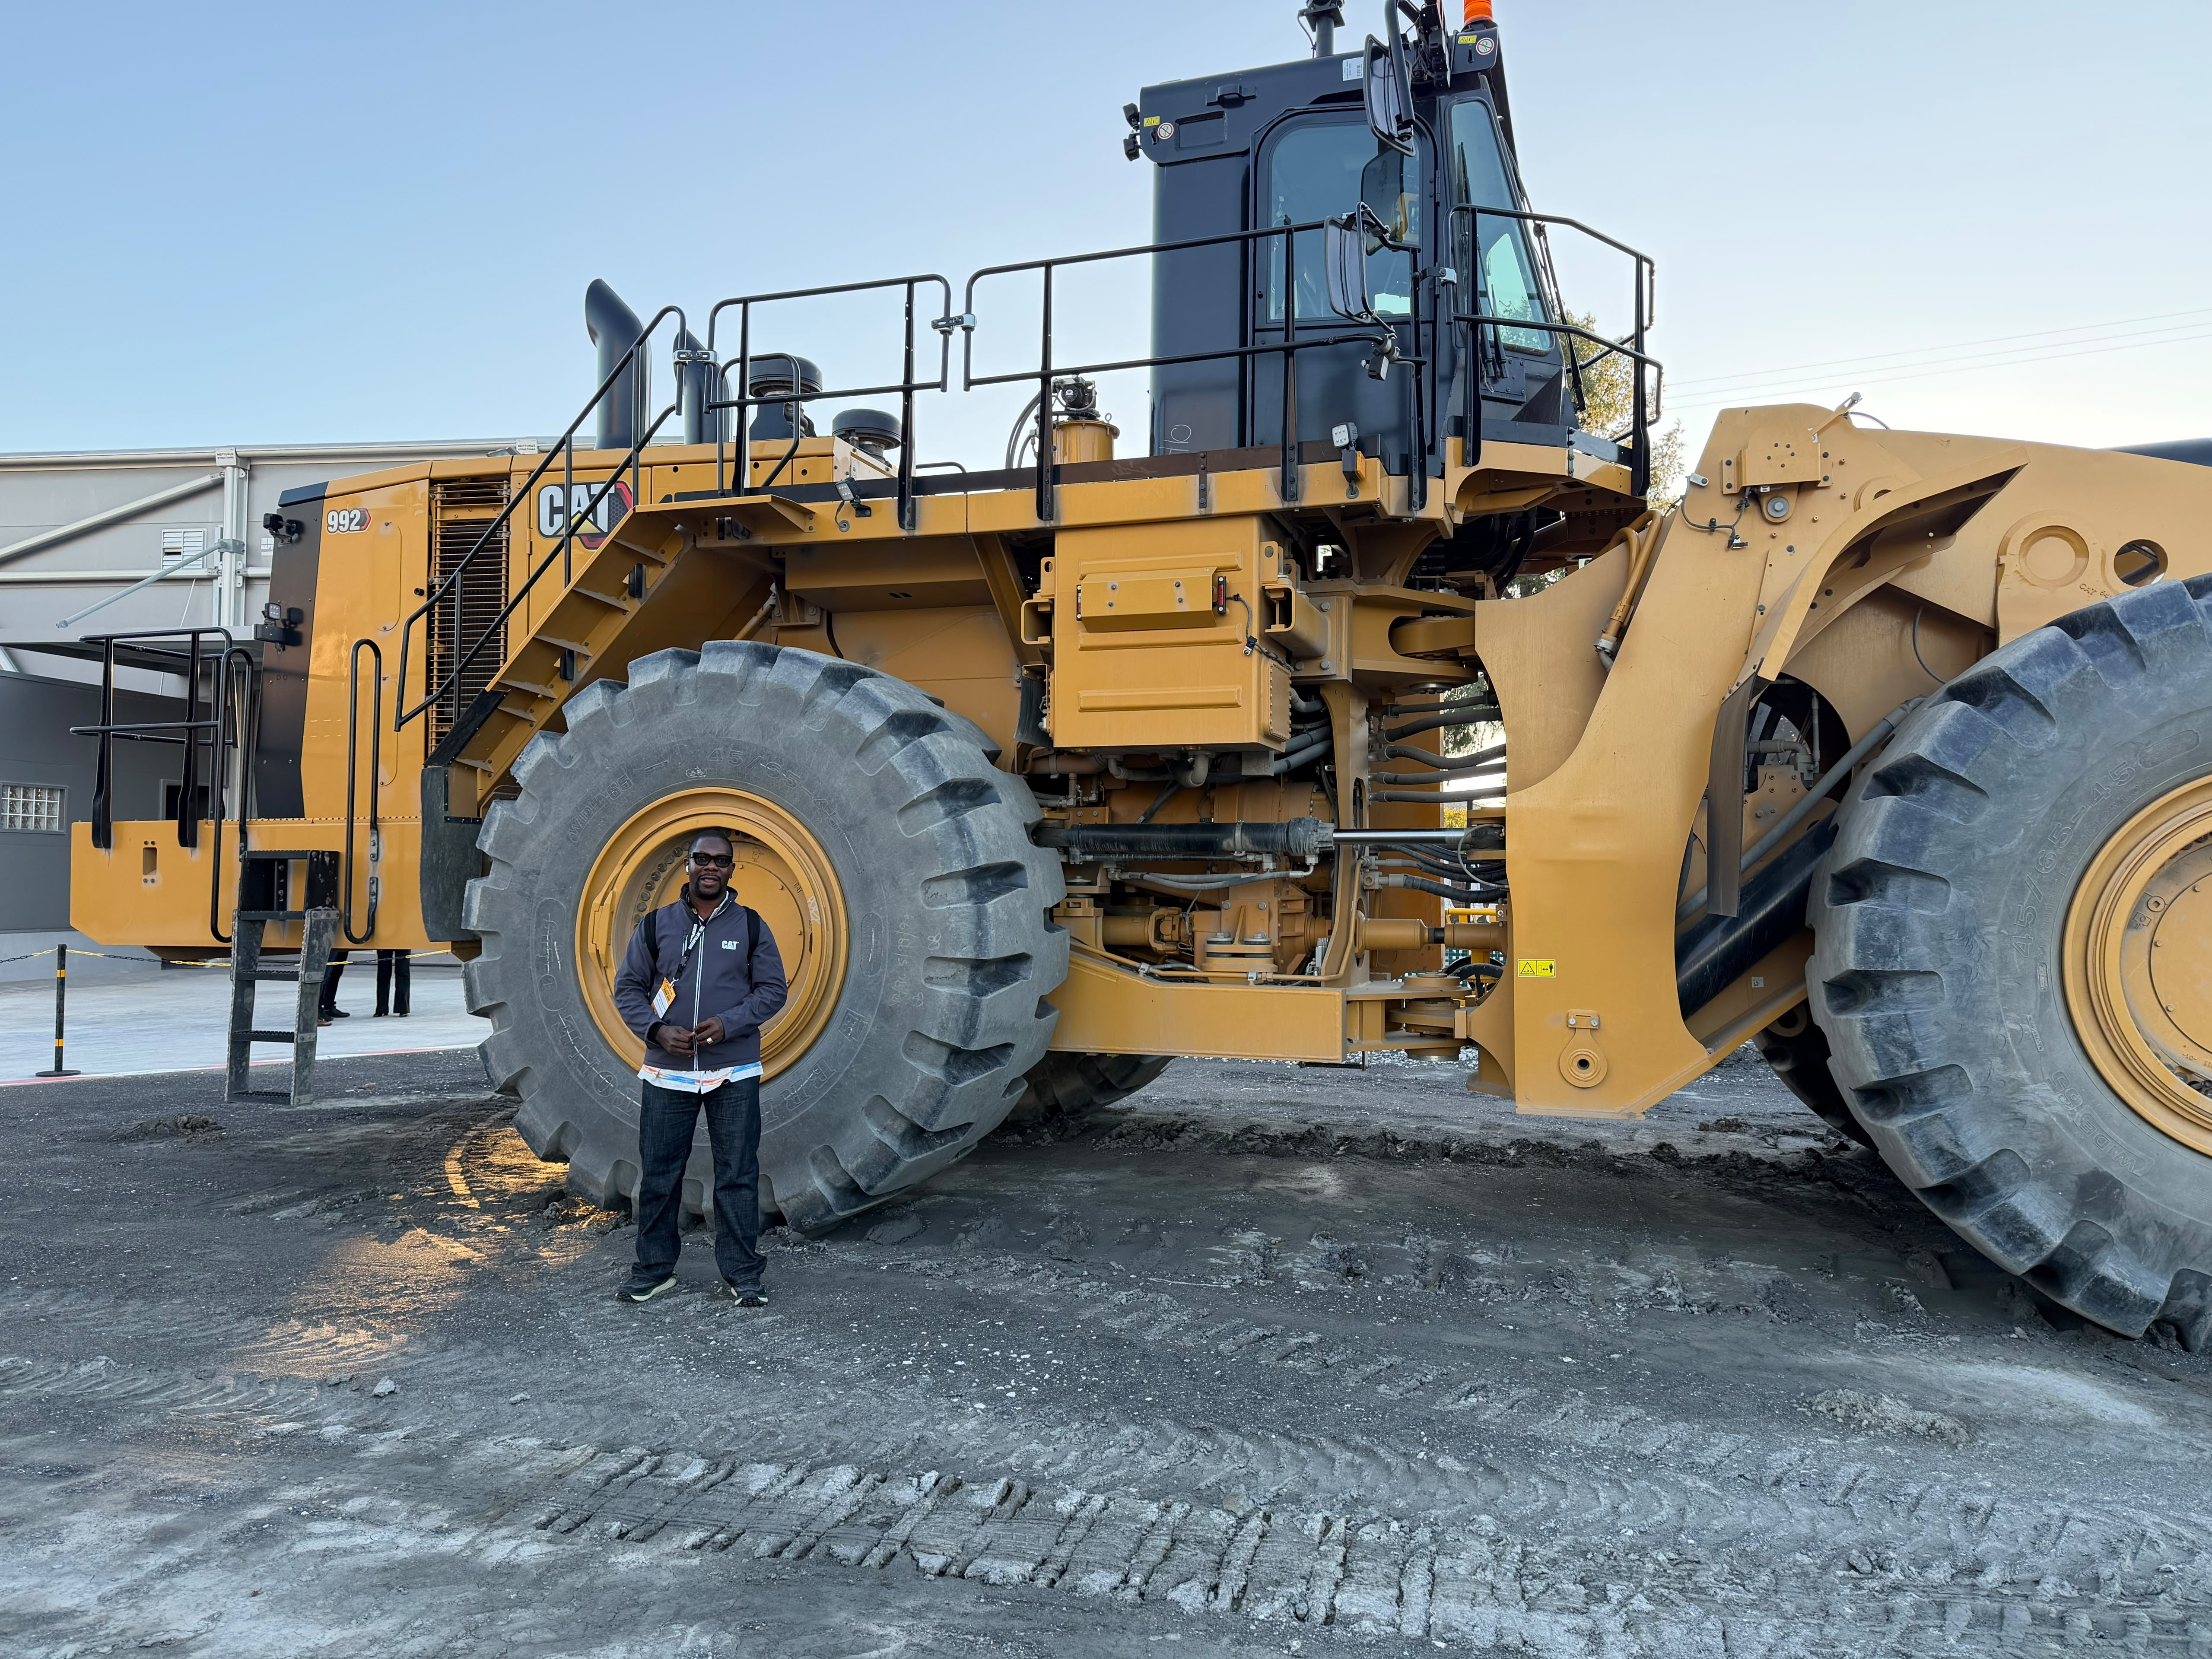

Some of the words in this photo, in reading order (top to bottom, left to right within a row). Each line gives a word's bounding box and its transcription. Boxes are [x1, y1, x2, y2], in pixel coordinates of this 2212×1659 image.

[327, 509, 361, 532] 992
[540, 483, 615, 536] CAT
[2012, 760, 2136, 958] 45/65-45
[722, 940, 737, 950] CAT
[2046, 1071, 2083, 1110] 65
[2076, 1119, 2136, 1173] WIDE
